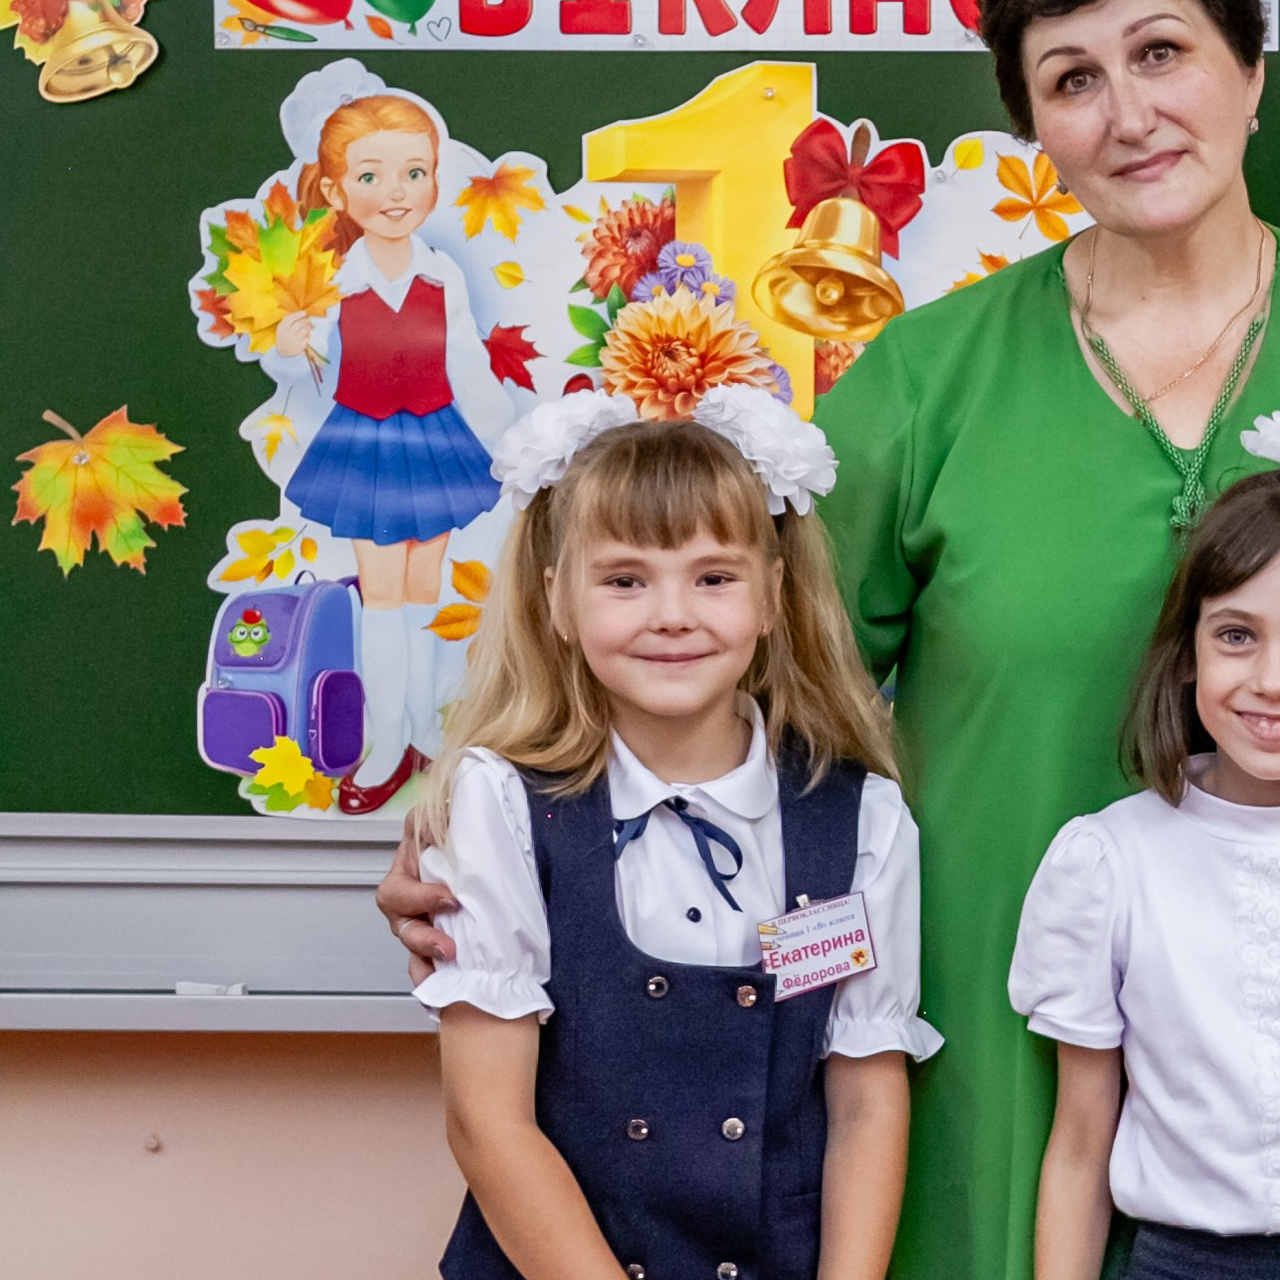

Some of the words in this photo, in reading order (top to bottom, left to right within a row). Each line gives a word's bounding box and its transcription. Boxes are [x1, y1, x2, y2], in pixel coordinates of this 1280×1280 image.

[587, 63, 813, 425] 1
[769, 928, 865, 970] Екатерина
[783, 960, 850, 989] Фёдорова
